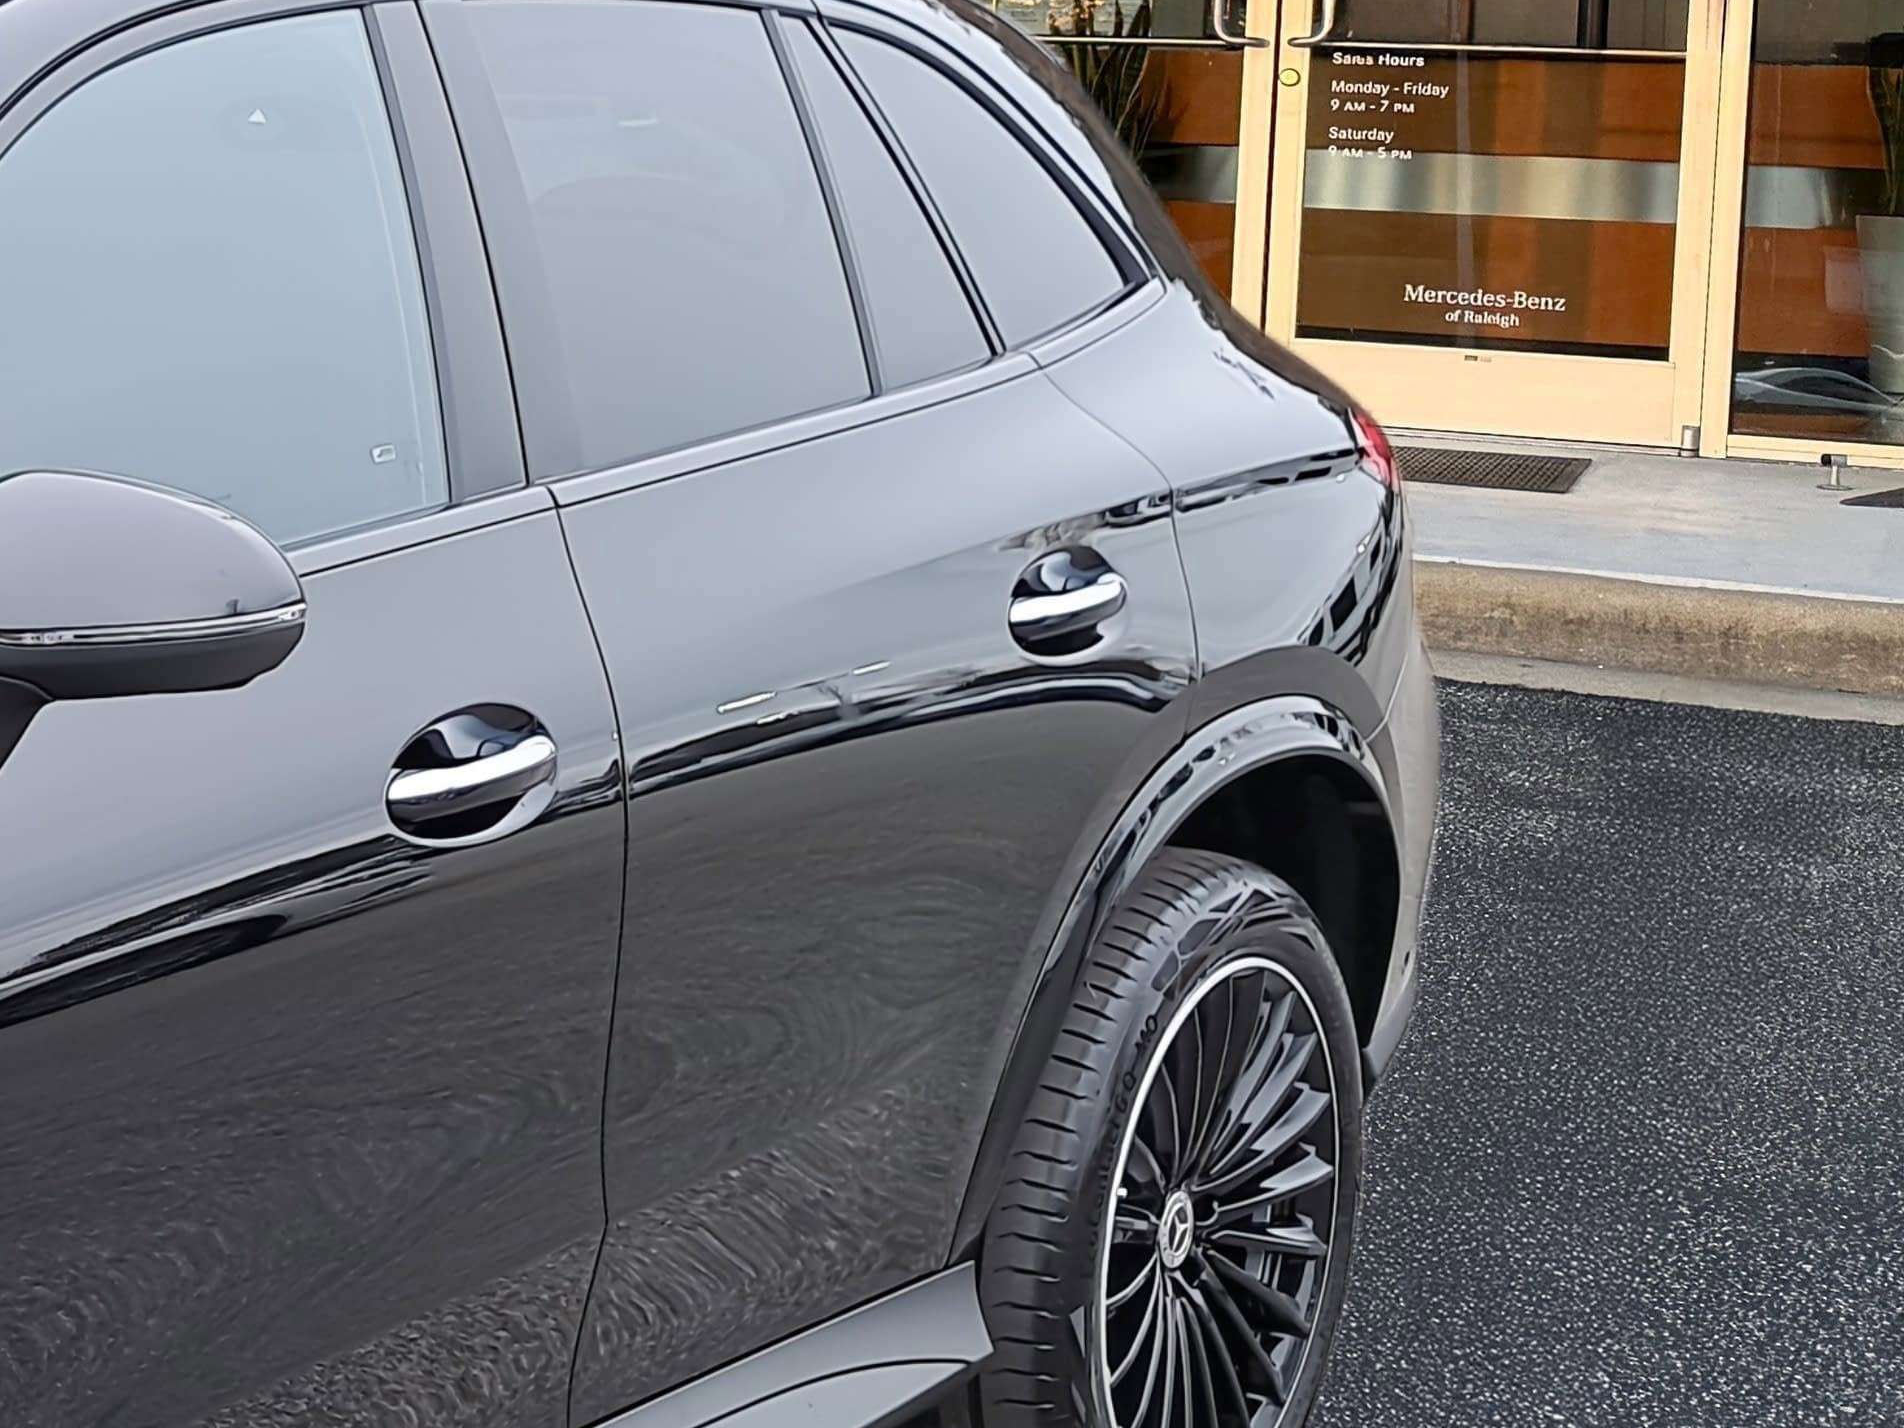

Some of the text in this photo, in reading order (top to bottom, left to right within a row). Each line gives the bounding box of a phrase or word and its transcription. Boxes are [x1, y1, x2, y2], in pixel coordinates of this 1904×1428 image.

[1378, 53, 1425, 67] Hours
[1331, 80, 1390, 97] Monday
[1403, 82, 1450, 99] Friday
[1330, 99, 1340, 111] 9
[1343, 101, 1366, 111] AM
[1379, 100, 1390, 112] 7
[1393, 103, 1415, 113] PM
[1328, 127, 1394, 144] Saturday
[1328, 145, 1337, 157] 9
[1342, 148, 1364, 158] AM
[1377, 147, 1387, 159] 5
[1391, 150, 1412, 160] PM
[1403, 283, 1566, 312] Mercedes-Benz
[1445, 310, 1460, 322] of
